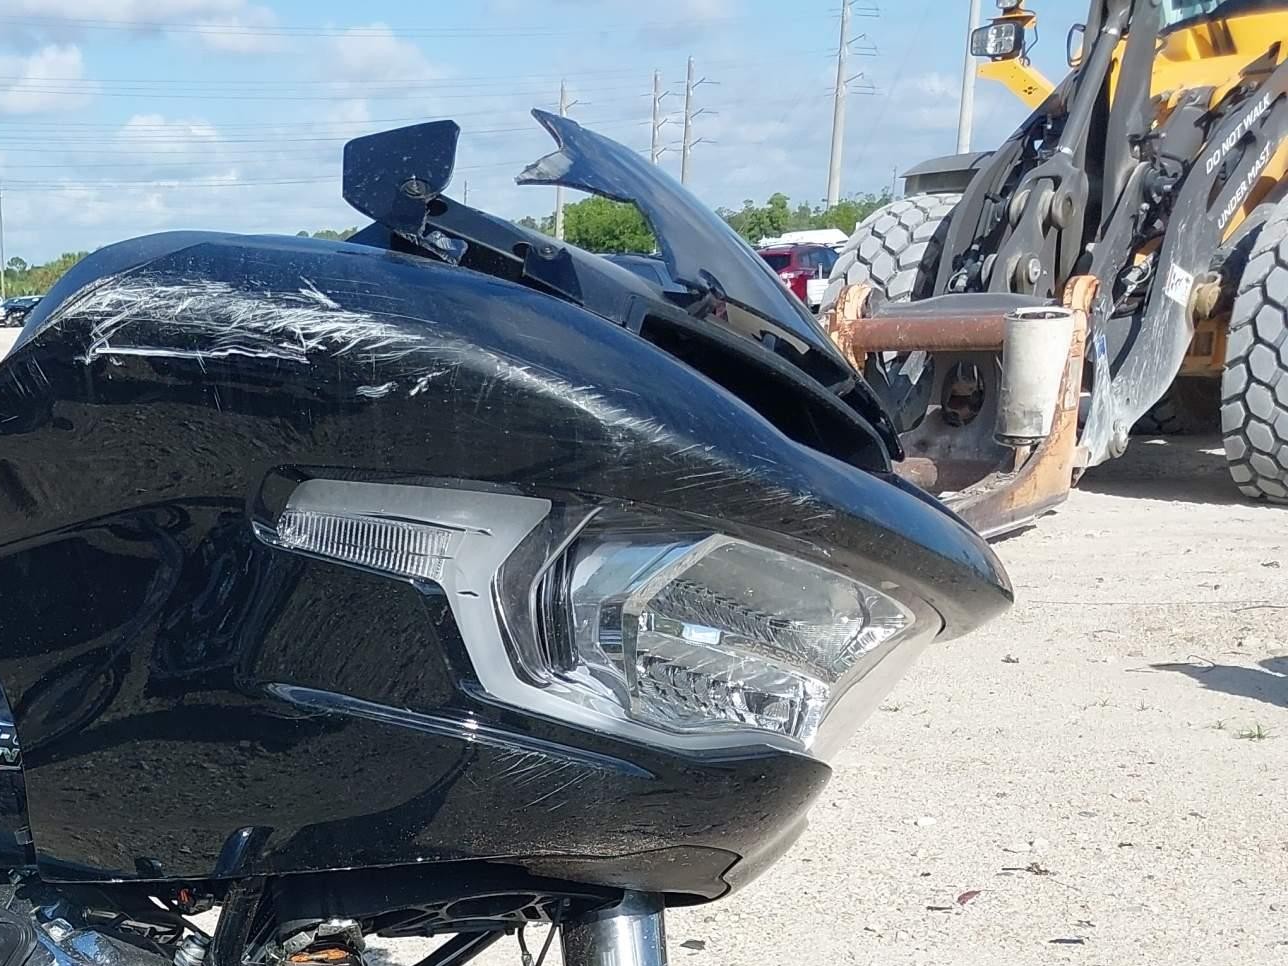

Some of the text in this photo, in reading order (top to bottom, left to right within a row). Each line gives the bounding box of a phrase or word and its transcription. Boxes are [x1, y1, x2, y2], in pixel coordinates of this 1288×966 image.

[1206, 92, 1271, 175] DO NOT WALK
[1217, 141, 1271, 230] UNDER MAST
